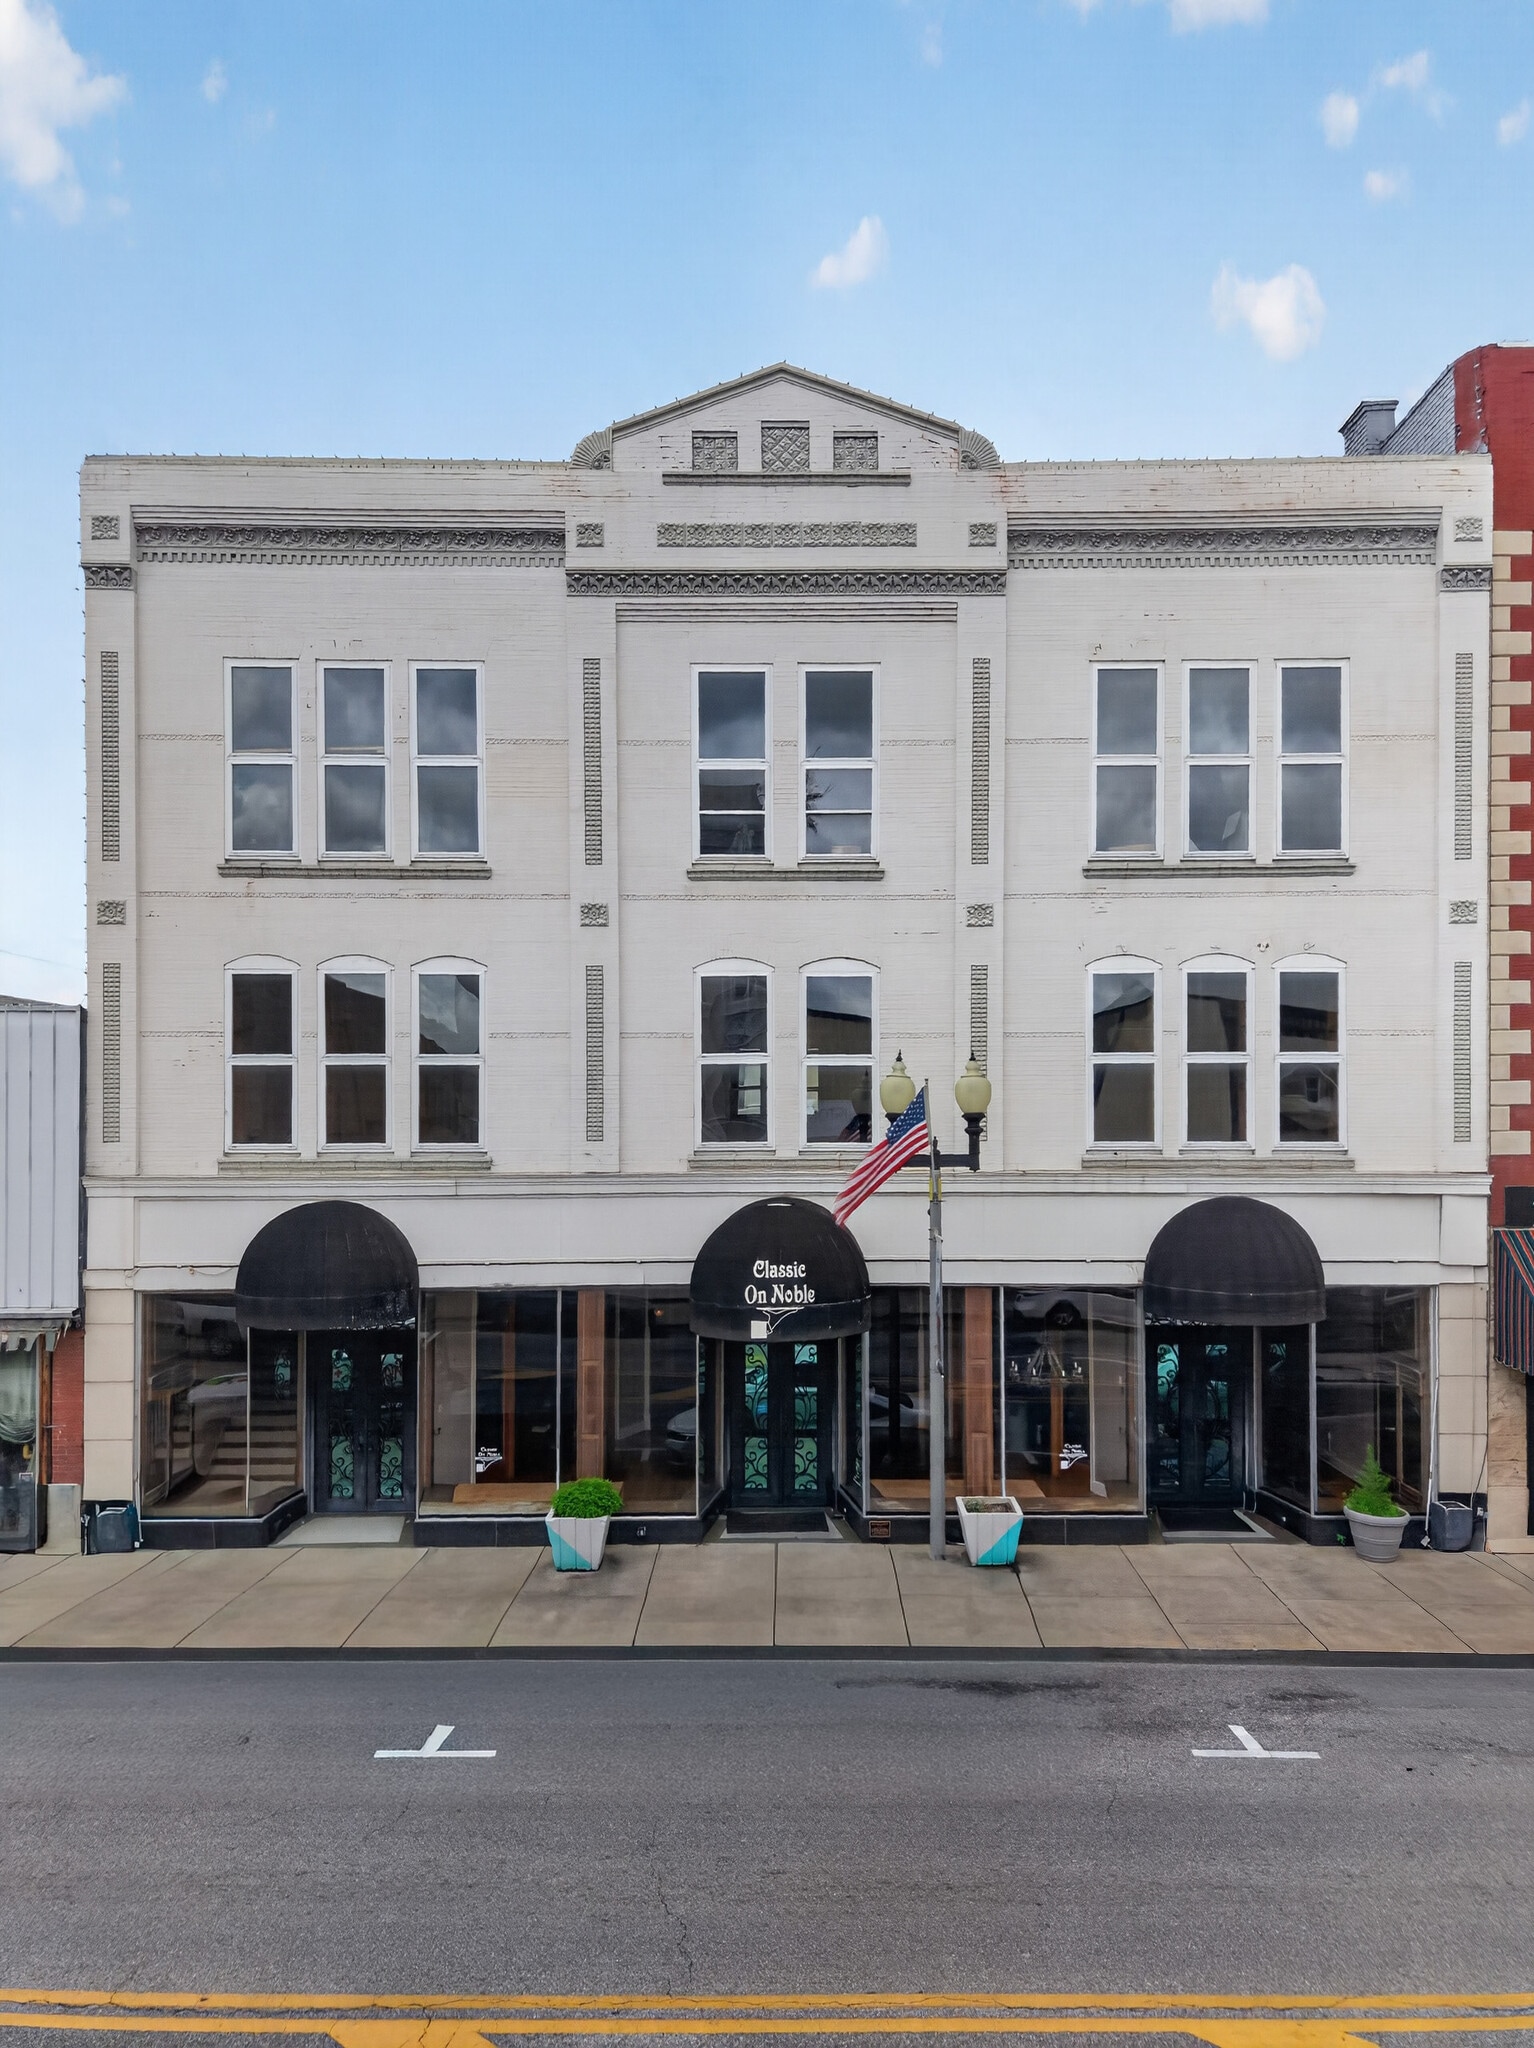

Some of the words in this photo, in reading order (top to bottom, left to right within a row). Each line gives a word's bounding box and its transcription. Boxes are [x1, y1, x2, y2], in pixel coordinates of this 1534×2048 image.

[753, 1260, 806, 1279] Classic
[744, 1285, 767, 1304] On
[771, 1284, 815, 1304] Noble
